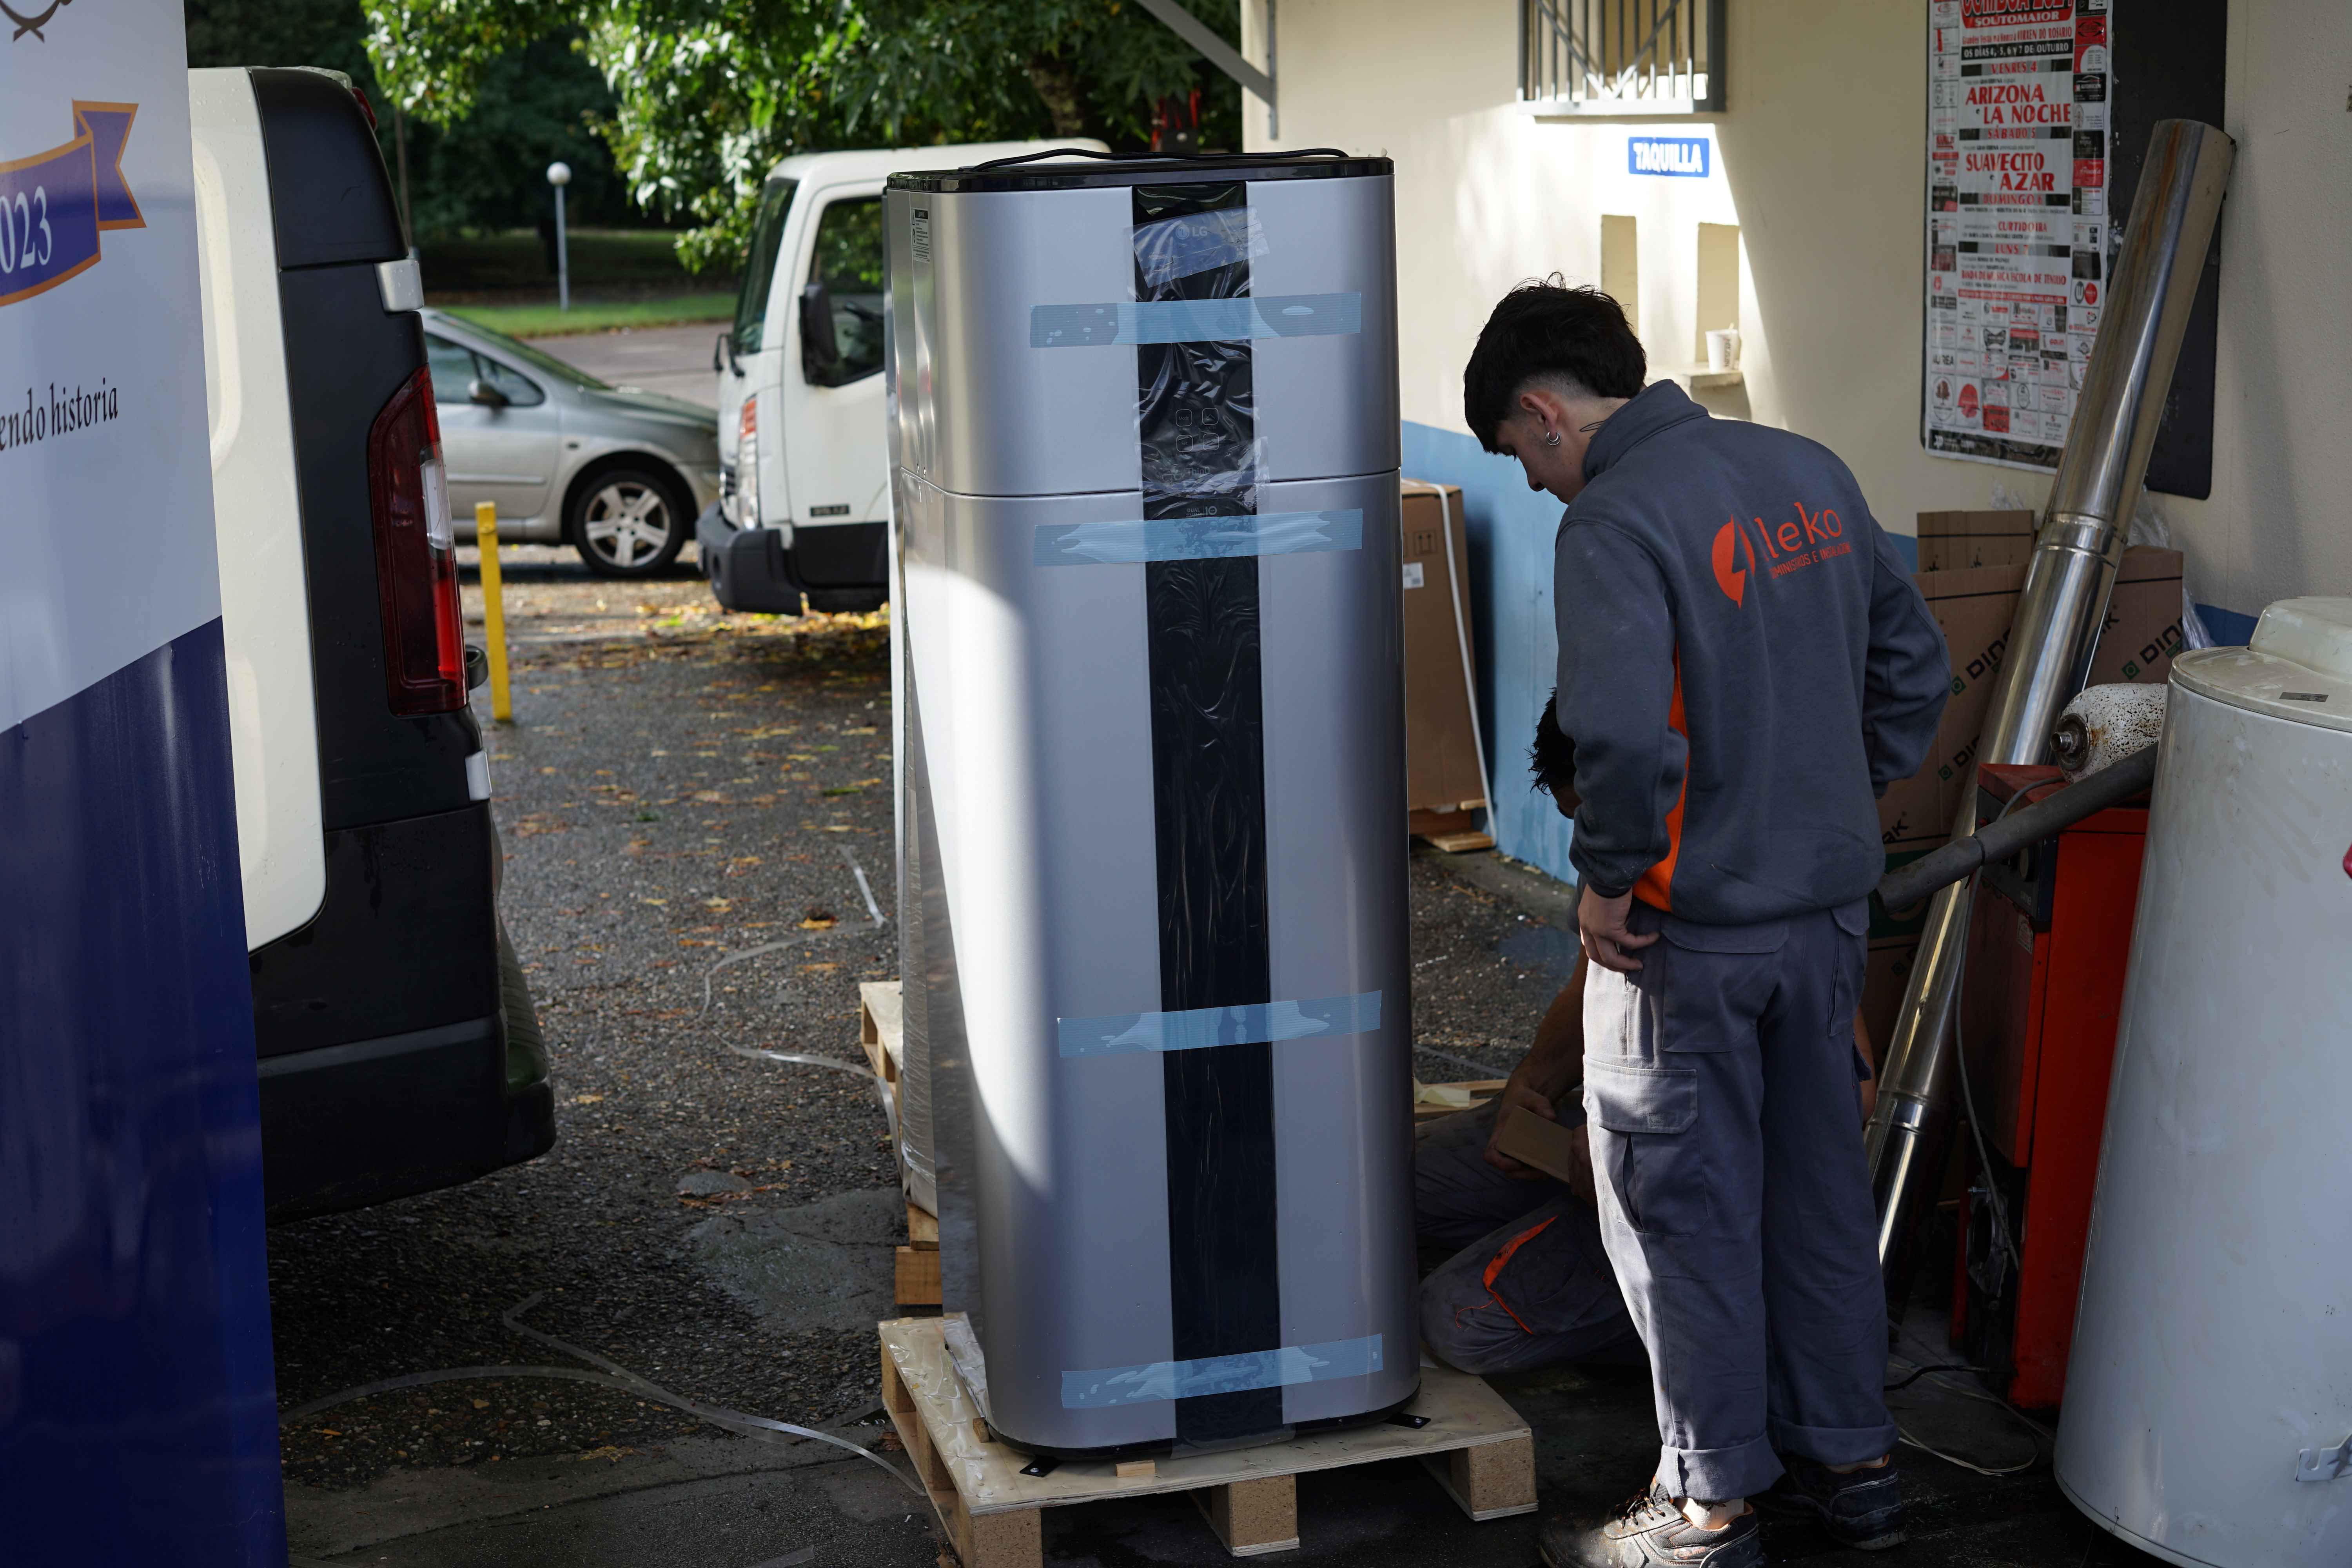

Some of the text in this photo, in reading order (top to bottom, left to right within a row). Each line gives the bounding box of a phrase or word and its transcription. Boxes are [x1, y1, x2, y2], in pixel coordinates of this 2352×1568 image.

[1975, 11, 2059, 26] SOUTOMAIOR
[2039, 28, 2046, 38] DO
[2048, 26, 2072, 38] ROSARIO
[1964, 49, 1973, 58] OS
[2007, 46, 2011, 55] 6
[2019, 45, 2023, 54] 7
[2024, 45, 2033, 53] DE
[2036, 42, 2069, 52] OUTUBRO
[1991, 61, 2037, 74] VENRES 4
[1965, 83, 2045, 105] ARIZONA
[1984, 106, 2004, 124] LA
[2012, 103, 2071, 123] NOCHE
[1988, 125, 2036, 139] SÁBADO 5
[1633, 142, 1703, 172] TAQUILLA
[1966, 152, 2044, 171] SUAVECITO
[2000, 172, 2054, 191] AZAR
[1983, 194, 2034, 205] DOMINGO
[1192, 226, 1207, 237] LG
[1995, 244, 2019, 254] LUNS
[2034, 274, 2042, 283] DE
[50, 377, 118, 437] historia
[1754, 502, 1842, 559] leko
